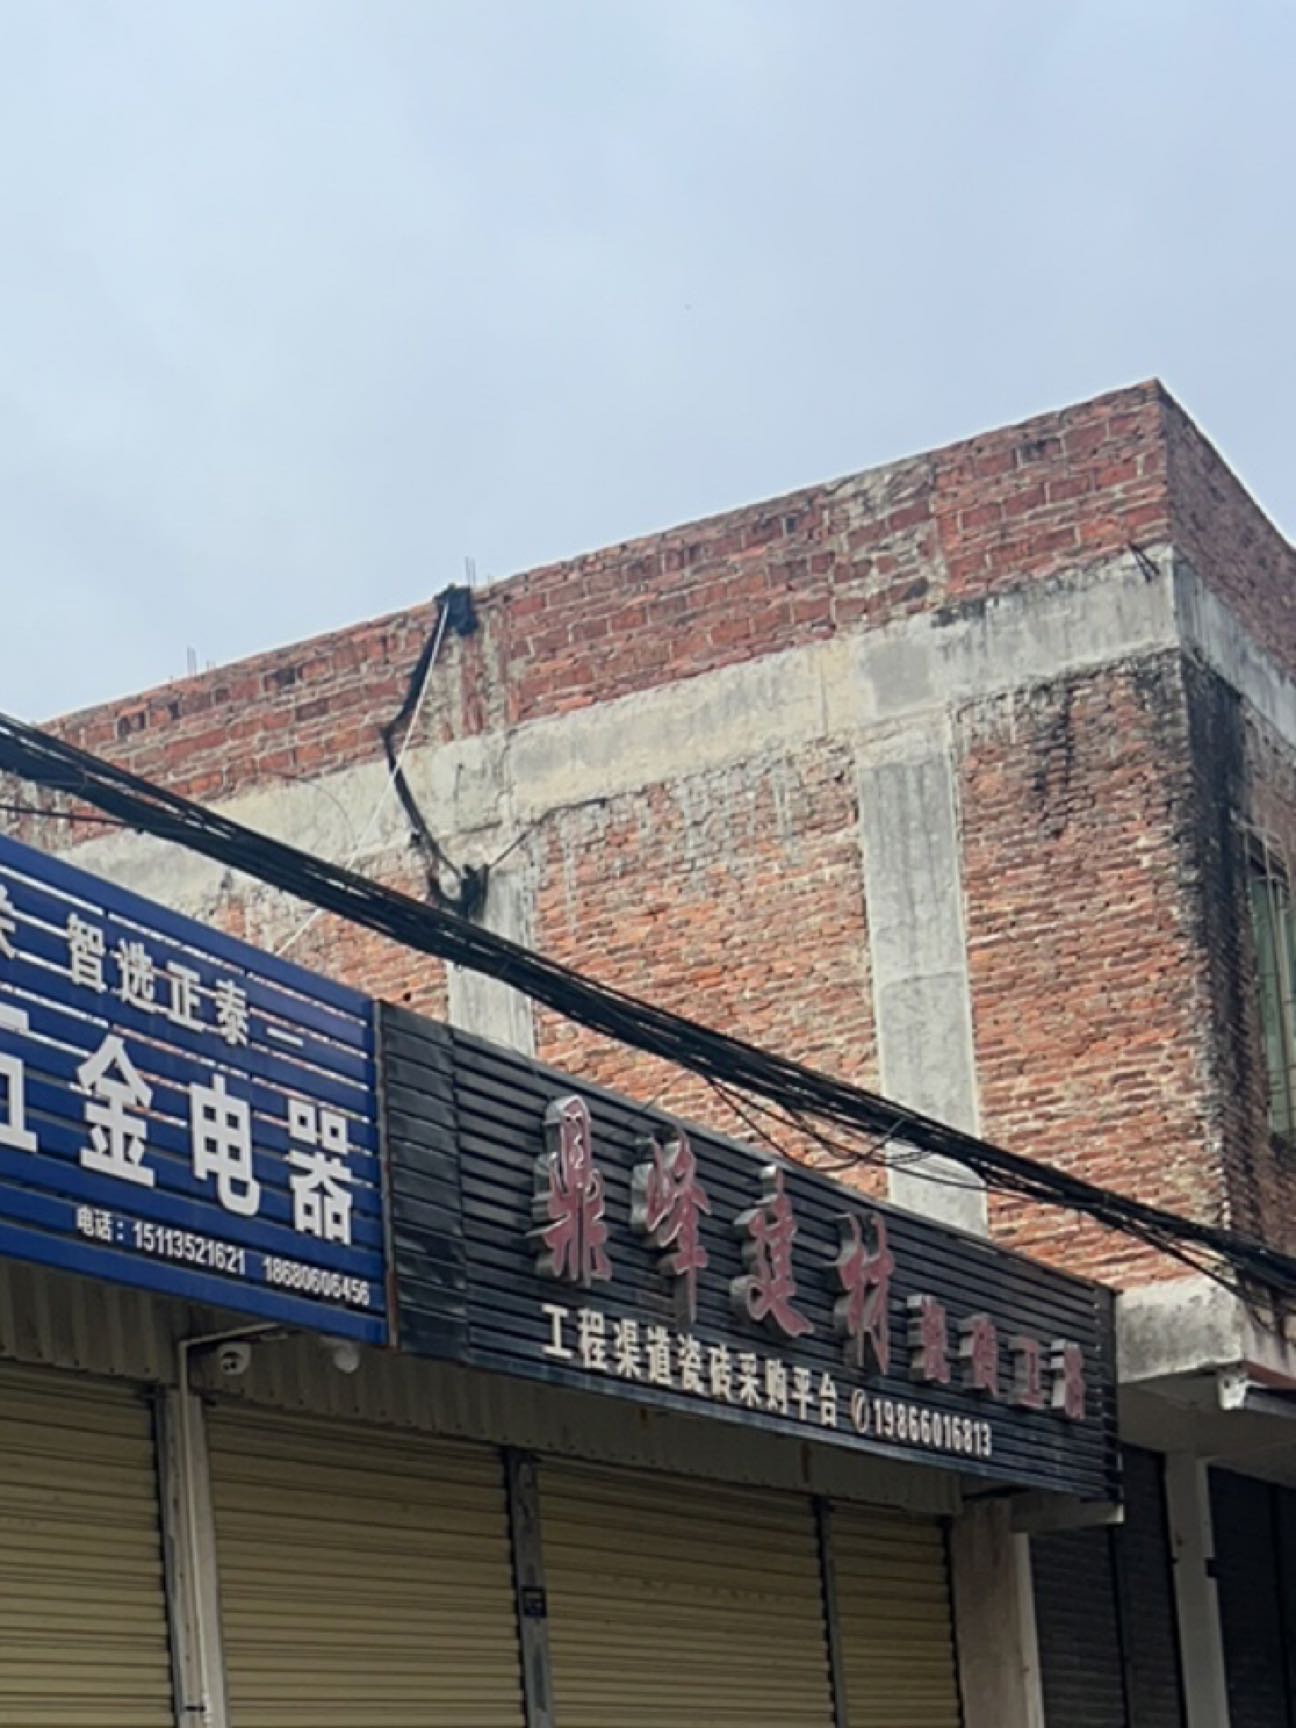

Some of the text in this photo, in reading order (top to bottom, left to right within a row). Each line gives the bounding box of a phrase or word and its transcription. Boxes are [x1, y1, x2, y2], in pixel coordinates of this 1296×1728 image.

[66, 912, 251, 1048] 智选正泰
[540, 1302, 839, 1429] 工程渠道瓷砖采购平台
